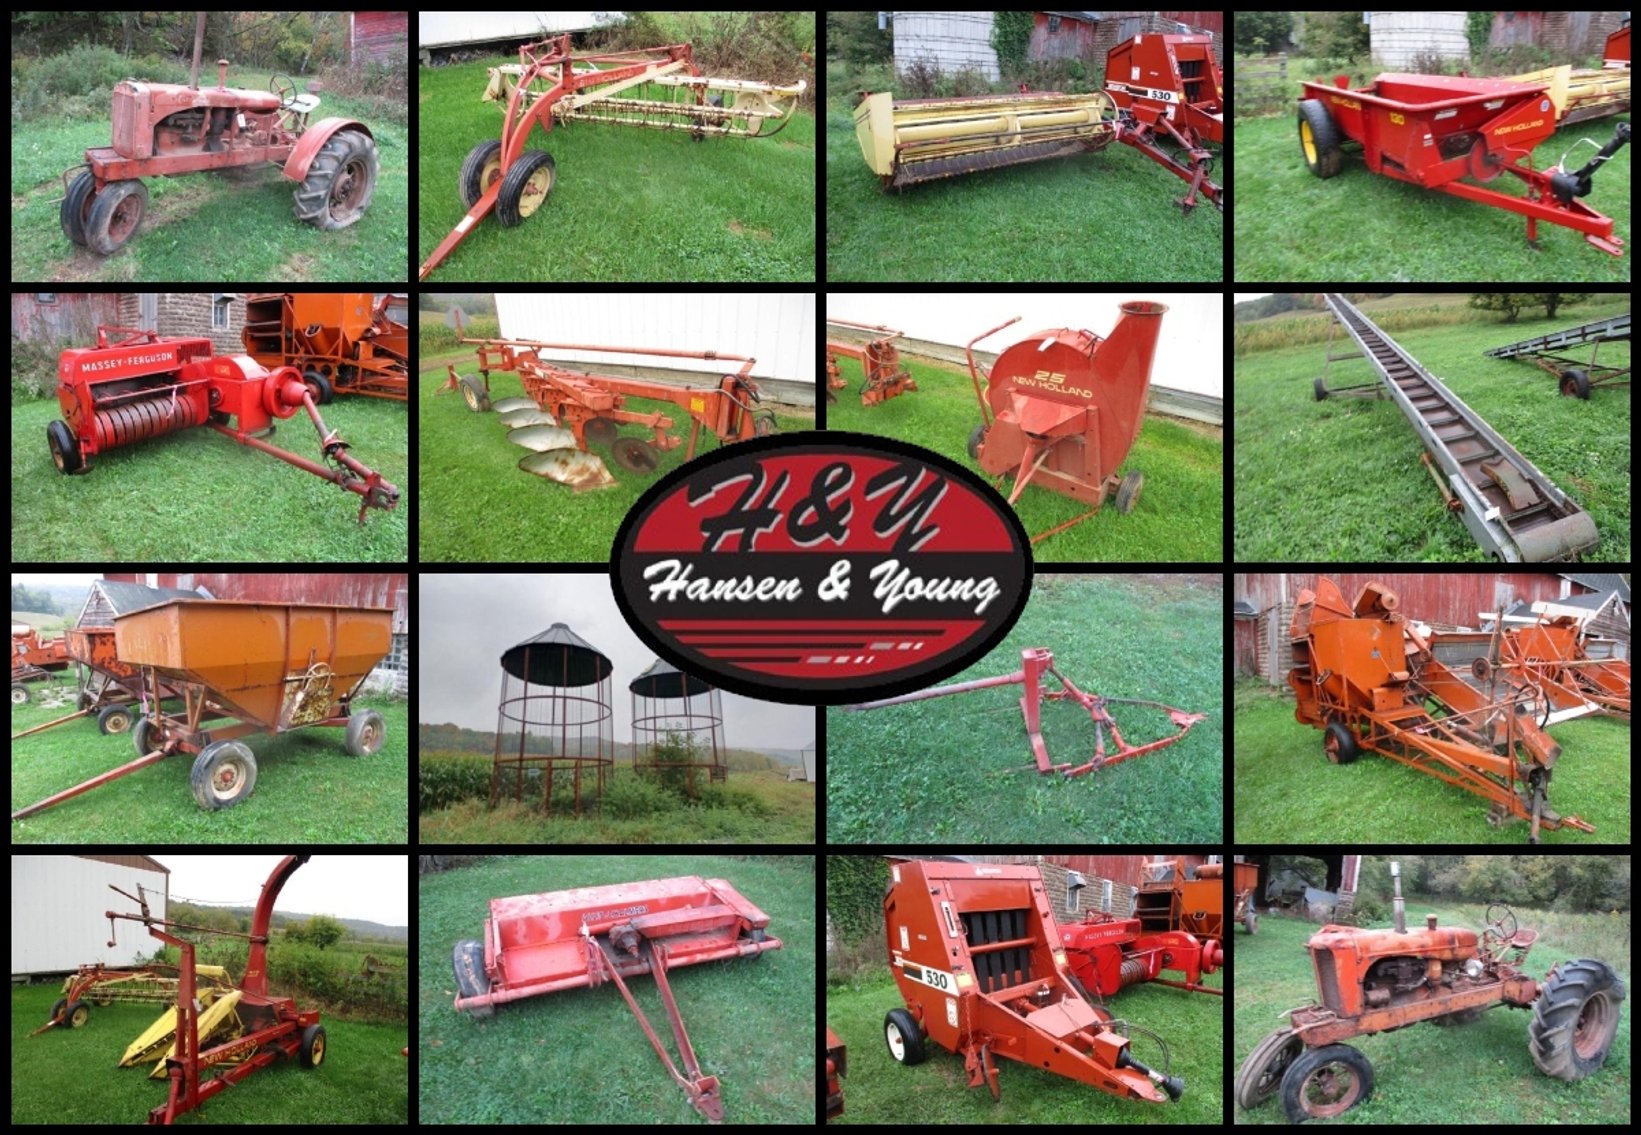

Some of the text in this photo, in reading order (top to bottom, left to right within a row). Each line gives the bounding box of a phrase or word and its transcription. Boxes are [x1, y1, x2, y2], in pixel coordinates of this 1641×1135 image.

[1151, 90, 1171, 101] 530
[1034, 370, 1067, 384] 25
[1012, 375, 1093, 399] NEW HOLLAND
[925, 969, 948, 989] 530
